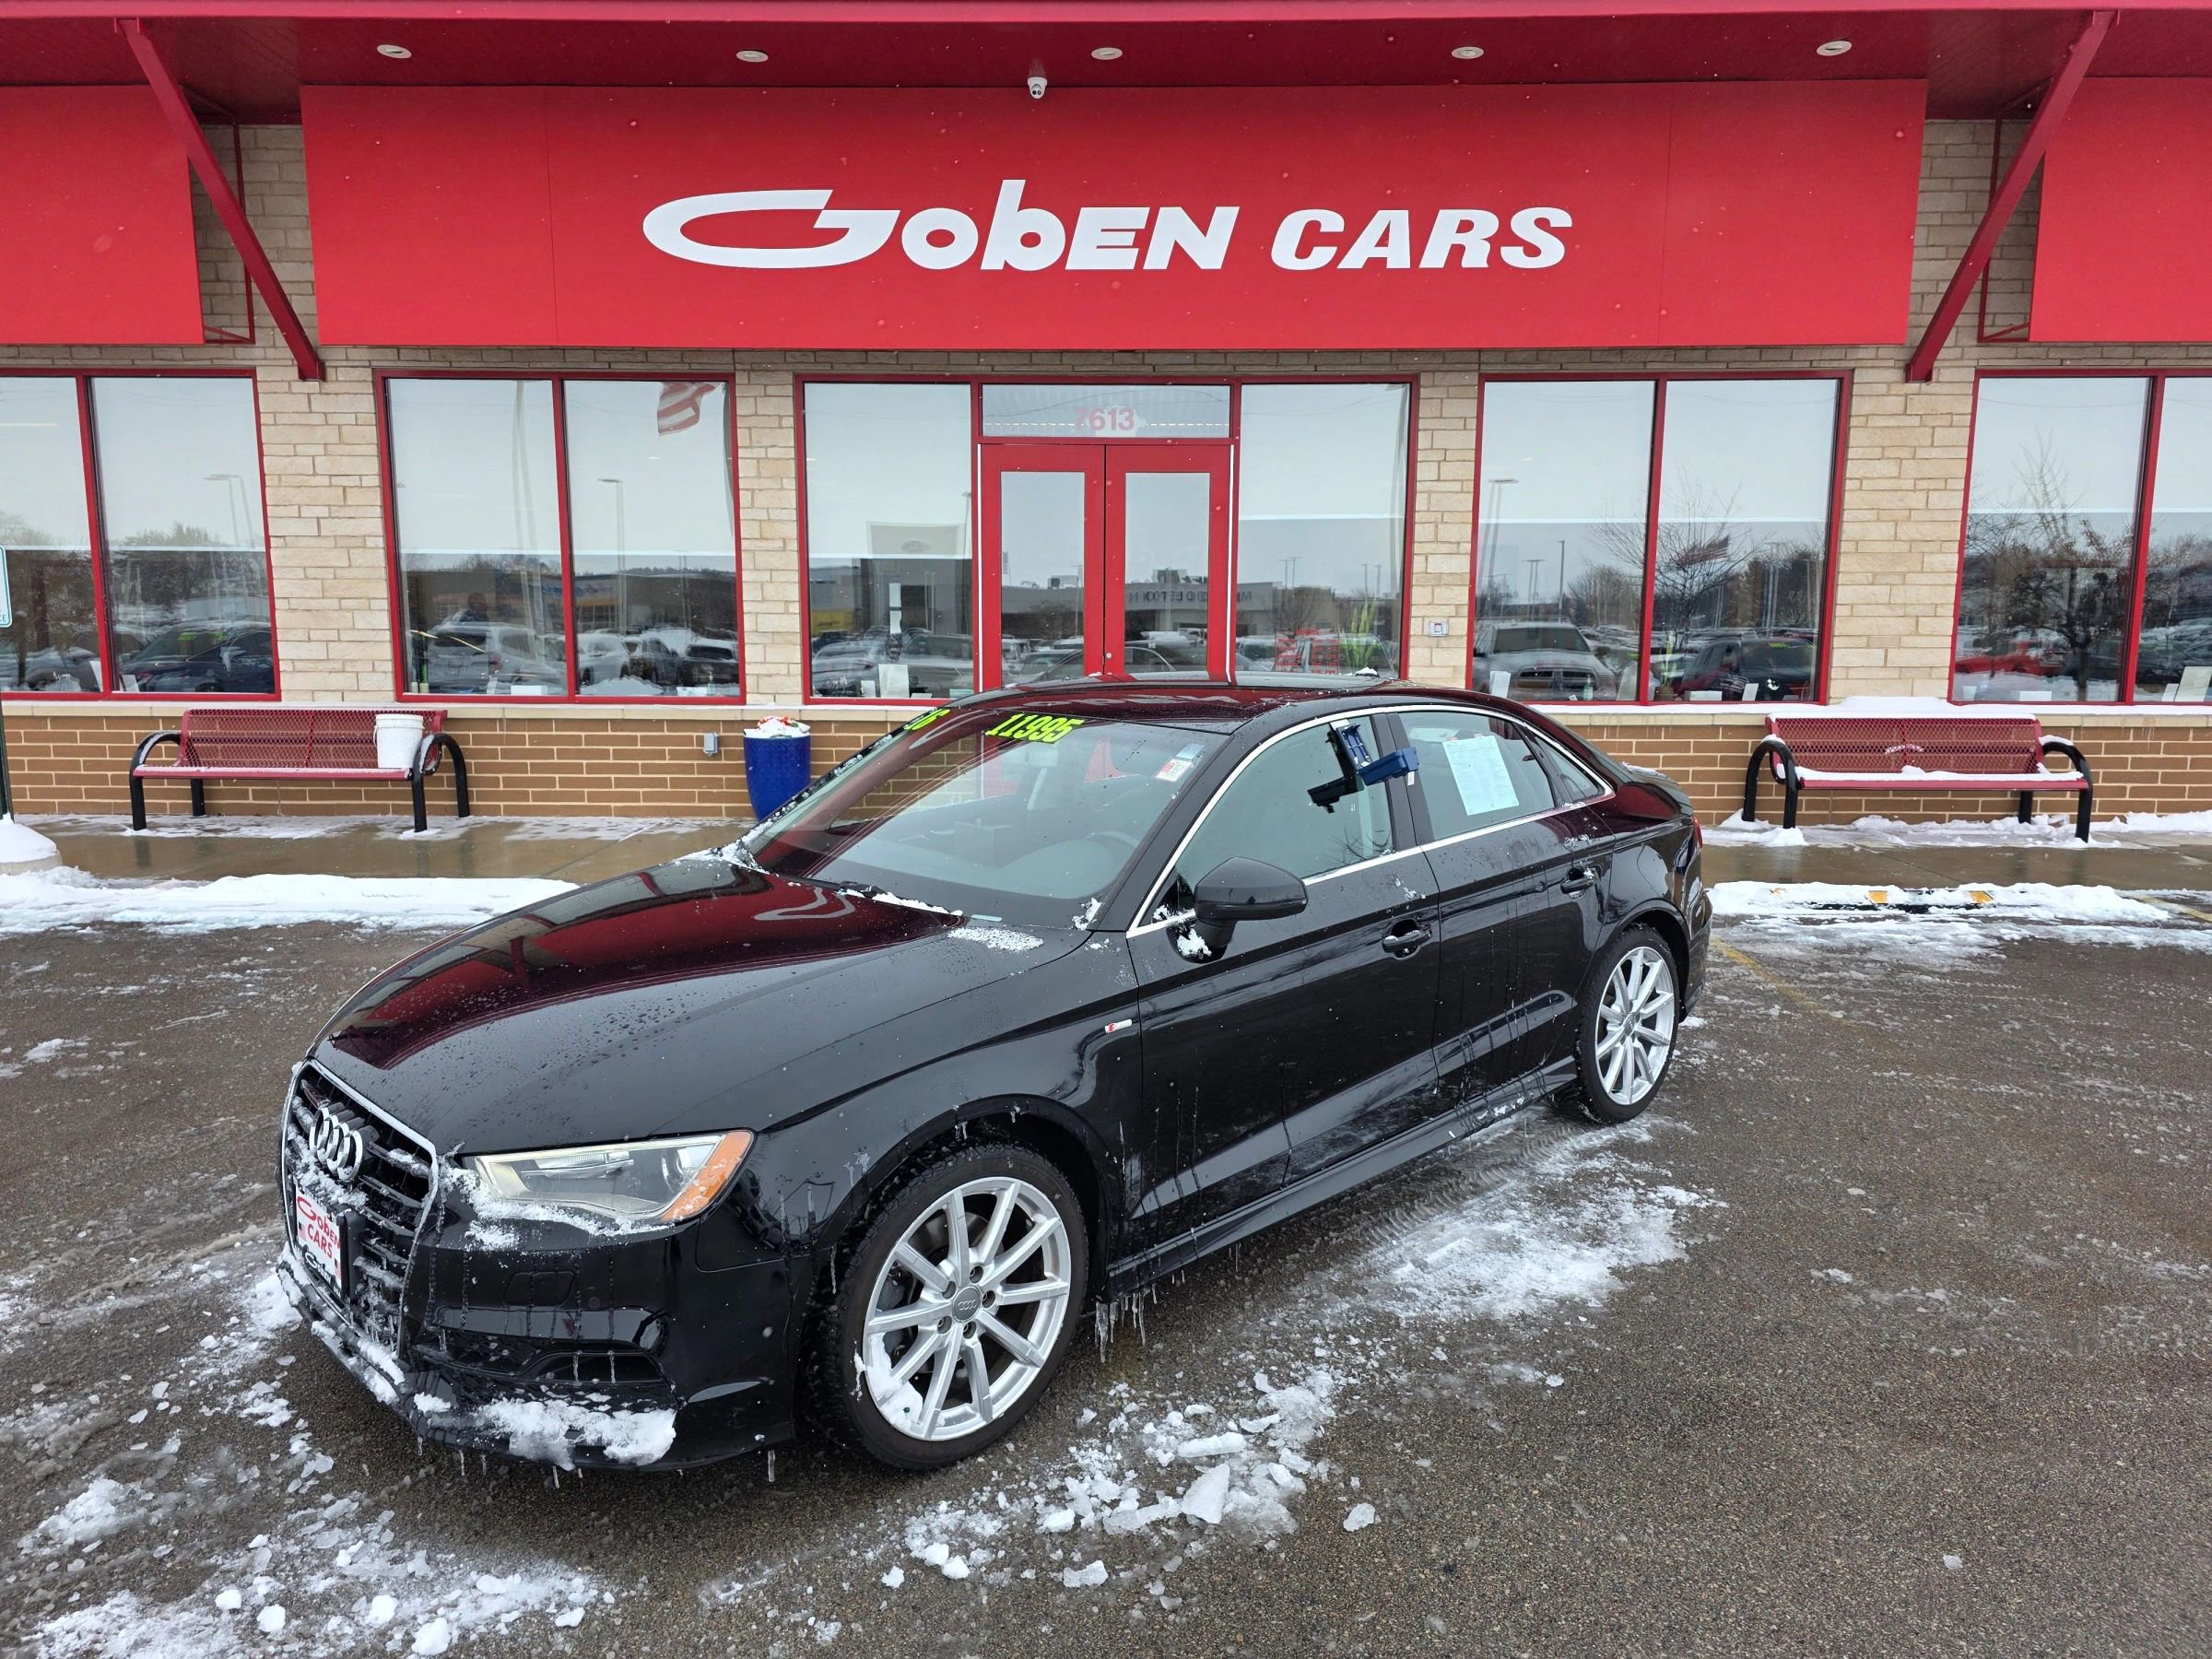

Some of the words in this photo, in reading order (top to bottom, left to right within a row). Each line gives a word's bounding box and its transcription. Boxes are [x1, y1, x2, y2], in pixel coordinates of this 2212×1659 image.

[1271, 206, 1573, 271] CARS
[1075, 406, 1135, 431] 7613
[983, 712, 1086, 743] 11995
[307, 1223, 333, 1259] CARS
